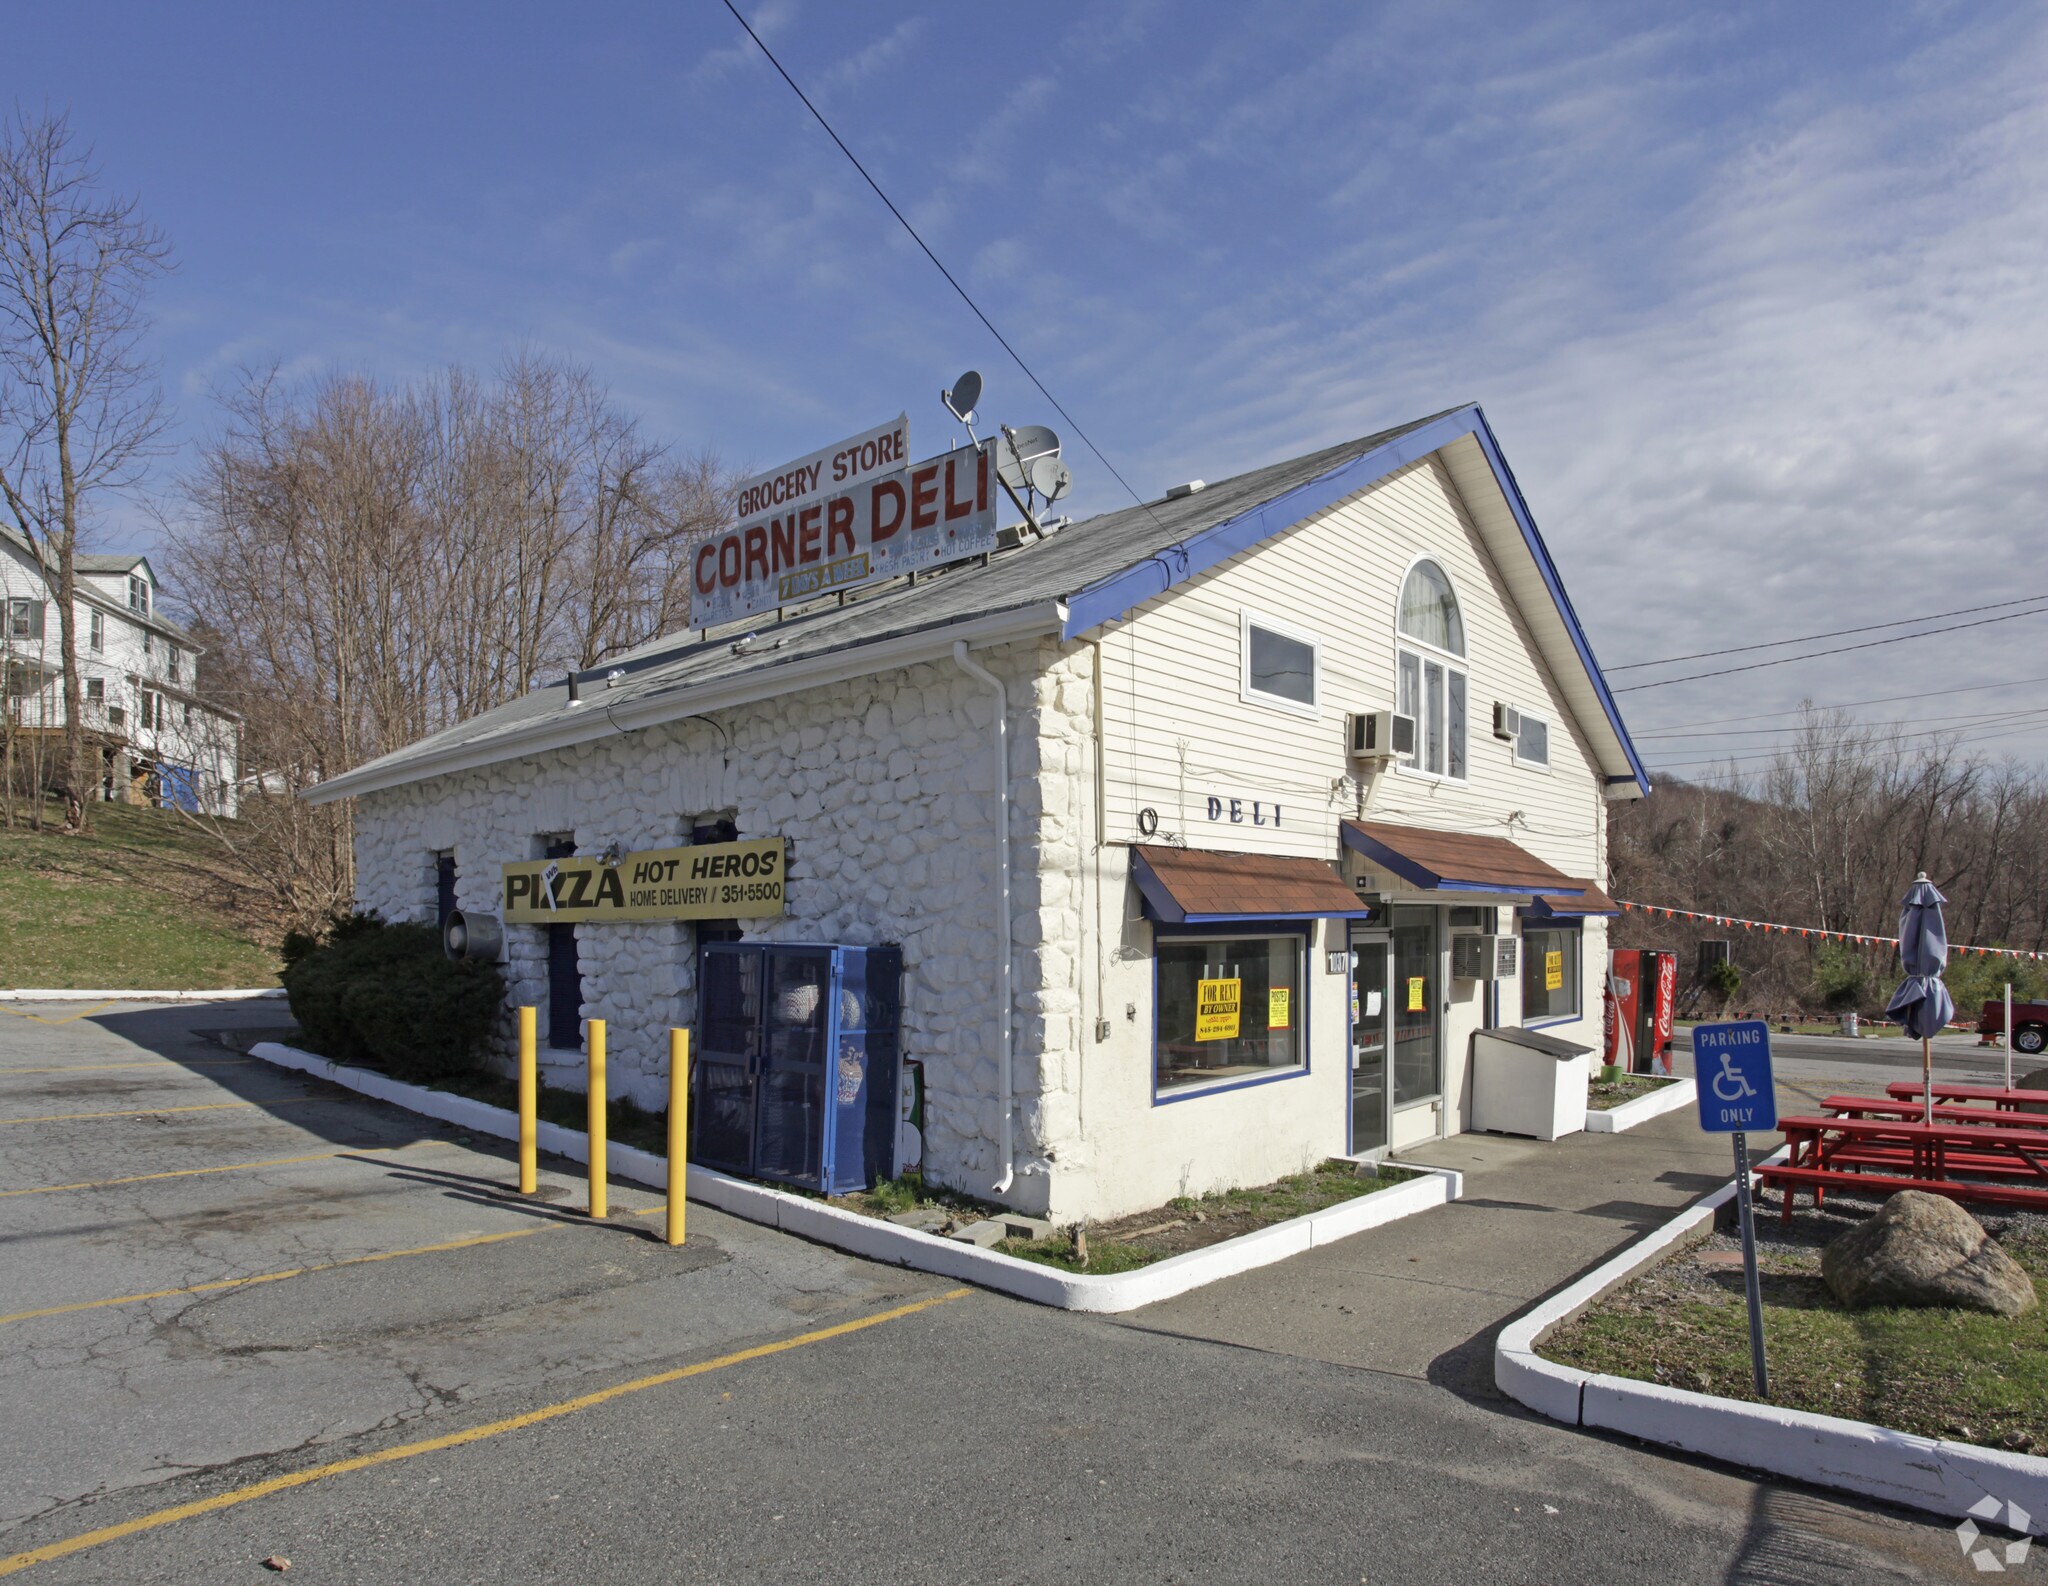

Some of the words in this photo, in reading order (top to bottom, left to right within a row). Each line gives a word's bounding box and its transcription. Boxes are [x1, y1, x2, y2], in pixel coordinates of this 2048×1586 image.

[738, 460, 823, 518] GROCERY
[833, 428, 904, 482] STORE
[695, 496, 856, 595] CORNER
[871, 448, 988, 544] DELI
[941, 541, 957, 558] HOT
[958, 536, 991, 553] COFFEE
[821, 567, 832, 587] A
[832, 557, 867, 583] WEEK
[1207, 796, 1281, 827] DELI
[633, 859, 680, 885] HOT
[691, 850, 778, 880] HEROS
[506, 868, 626, 910] PIZZA
[630, 889, 657, 907] HOME
[660, 886, 708, 906] DELIVERY
[1328, 952, 1345, 972] 1037
[1203, 985, 1217, 1002] FOR
[1219, 984, 1237, 1002] RENT
[1658, 958, 1673, 1037] Coca-Cola
[1213, 1003, 1236, 1013] OWNER
[1700, 1029, 1760, 1048] PARKING
[1720, 1107, 1753, 1123] ONLY
